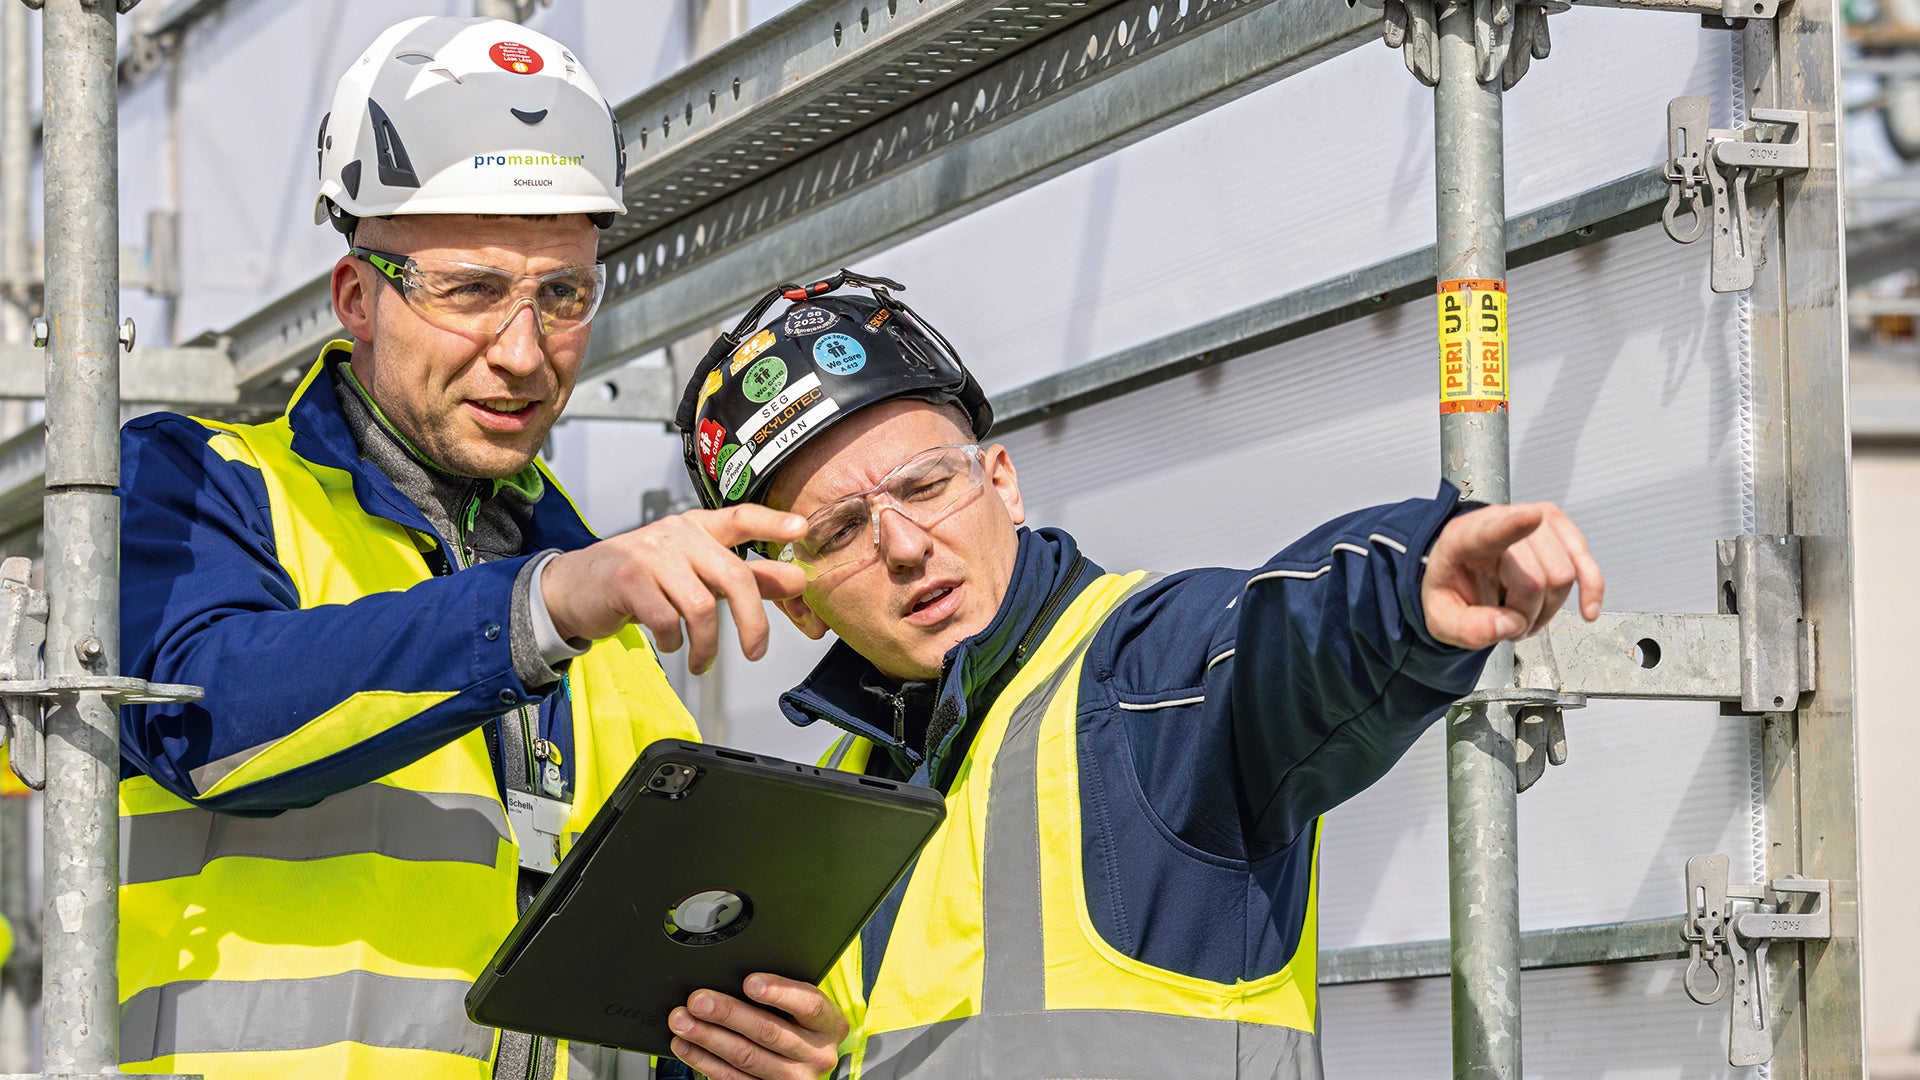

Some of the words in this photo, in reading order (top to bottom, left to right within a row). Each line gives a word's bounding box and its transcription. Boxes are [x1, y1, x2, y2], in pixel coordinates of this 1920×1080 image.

[474, 154, 582, 169] promaintain
[513, 179, 553, 187] SCHELLUCH
[793, 317, 825, 328] 2023
[1445, 295, 1462, 334] UP
[1482, 294, 1499, 332] UP
[826, 360, 841, 369] We
[843, 353, 862, 363] care
[1445, 342, 1463, 389] PERI
[1482, 341, 1500, 388] PERI
[755, 386, 767, 398] We
[768, 370, 784, 386] care
[754, 388, 822, 444] SKYLOTEC
[761, 394, 789, 418] SEG
[712, 429, 723, 455] care
[775, 420, 807, 449] IVAN
[710, 457, 717, 475] We
